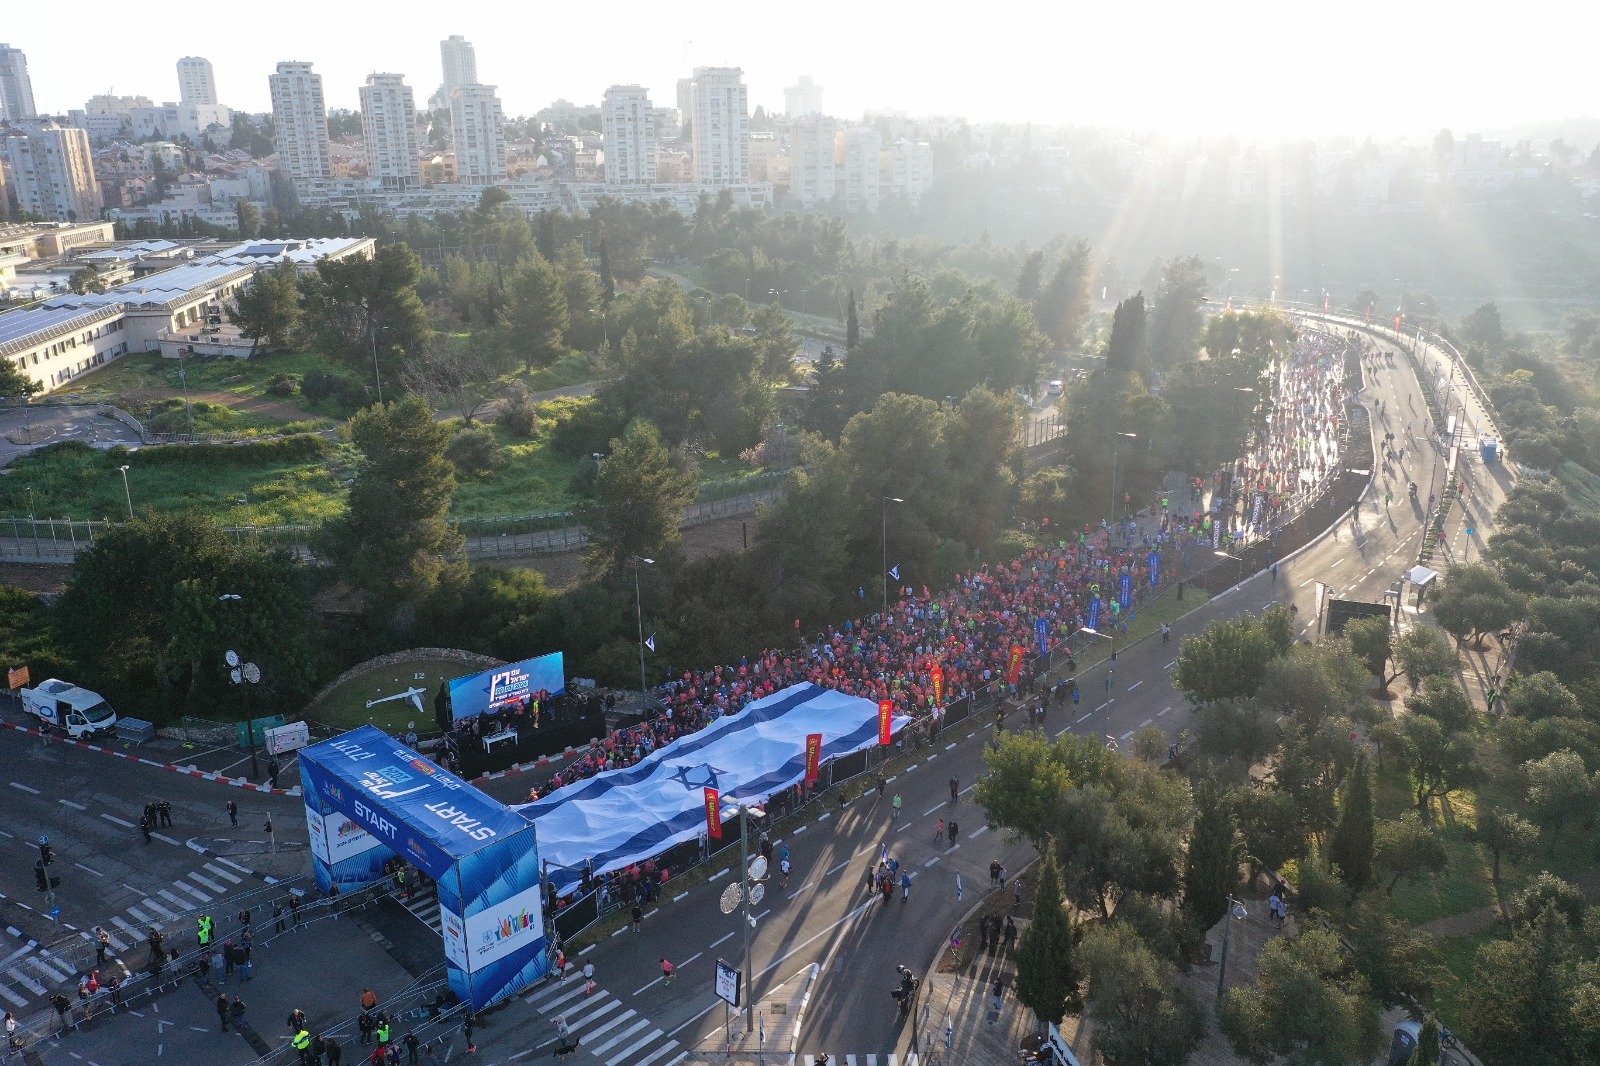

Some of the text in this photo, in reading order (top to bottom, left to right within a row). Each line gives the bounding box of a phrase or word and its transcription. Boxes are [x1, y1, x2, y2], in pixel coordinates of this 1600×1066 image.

[490, 671, 510, 702] רץ
[354, 800, 398, 840] START
[424, 801, 497, 841] START
[708, 801, 717, 832] Winner
